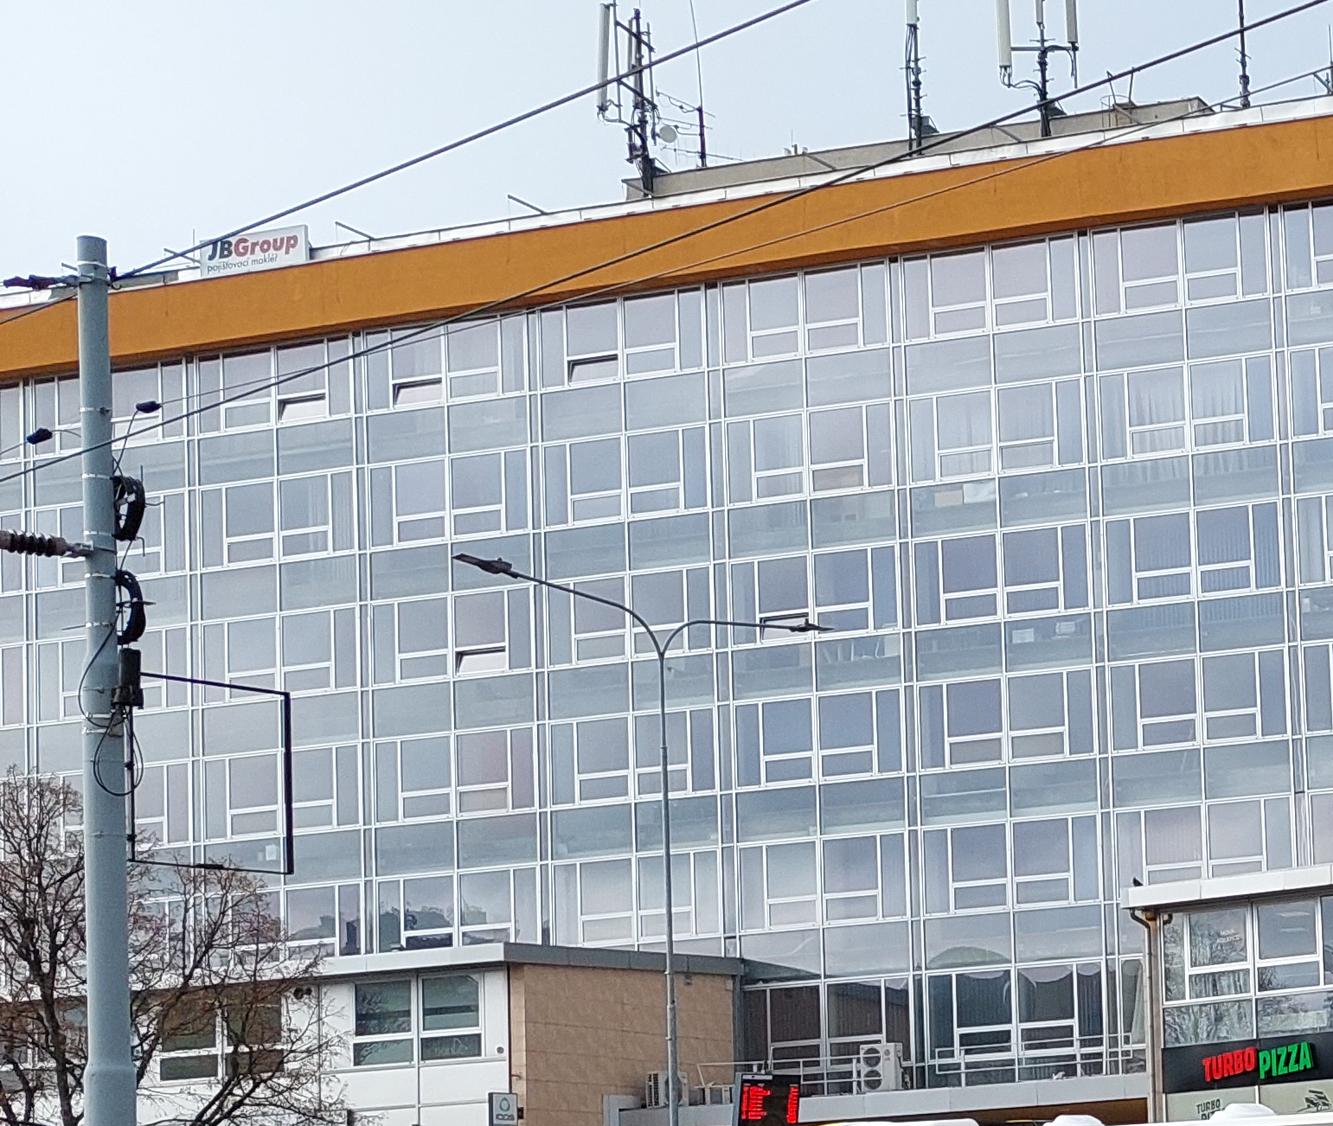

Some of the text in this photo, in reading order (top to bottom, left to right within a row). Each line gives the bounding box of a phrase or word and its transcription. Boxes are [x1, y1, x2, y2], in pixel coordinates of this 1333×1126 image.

[207, 235, 299, 261] JBGroup
[1202, 1041, 1313, 1082] TURBO PIZZA
[1196, 1098, 1221, 1114] TURBO
